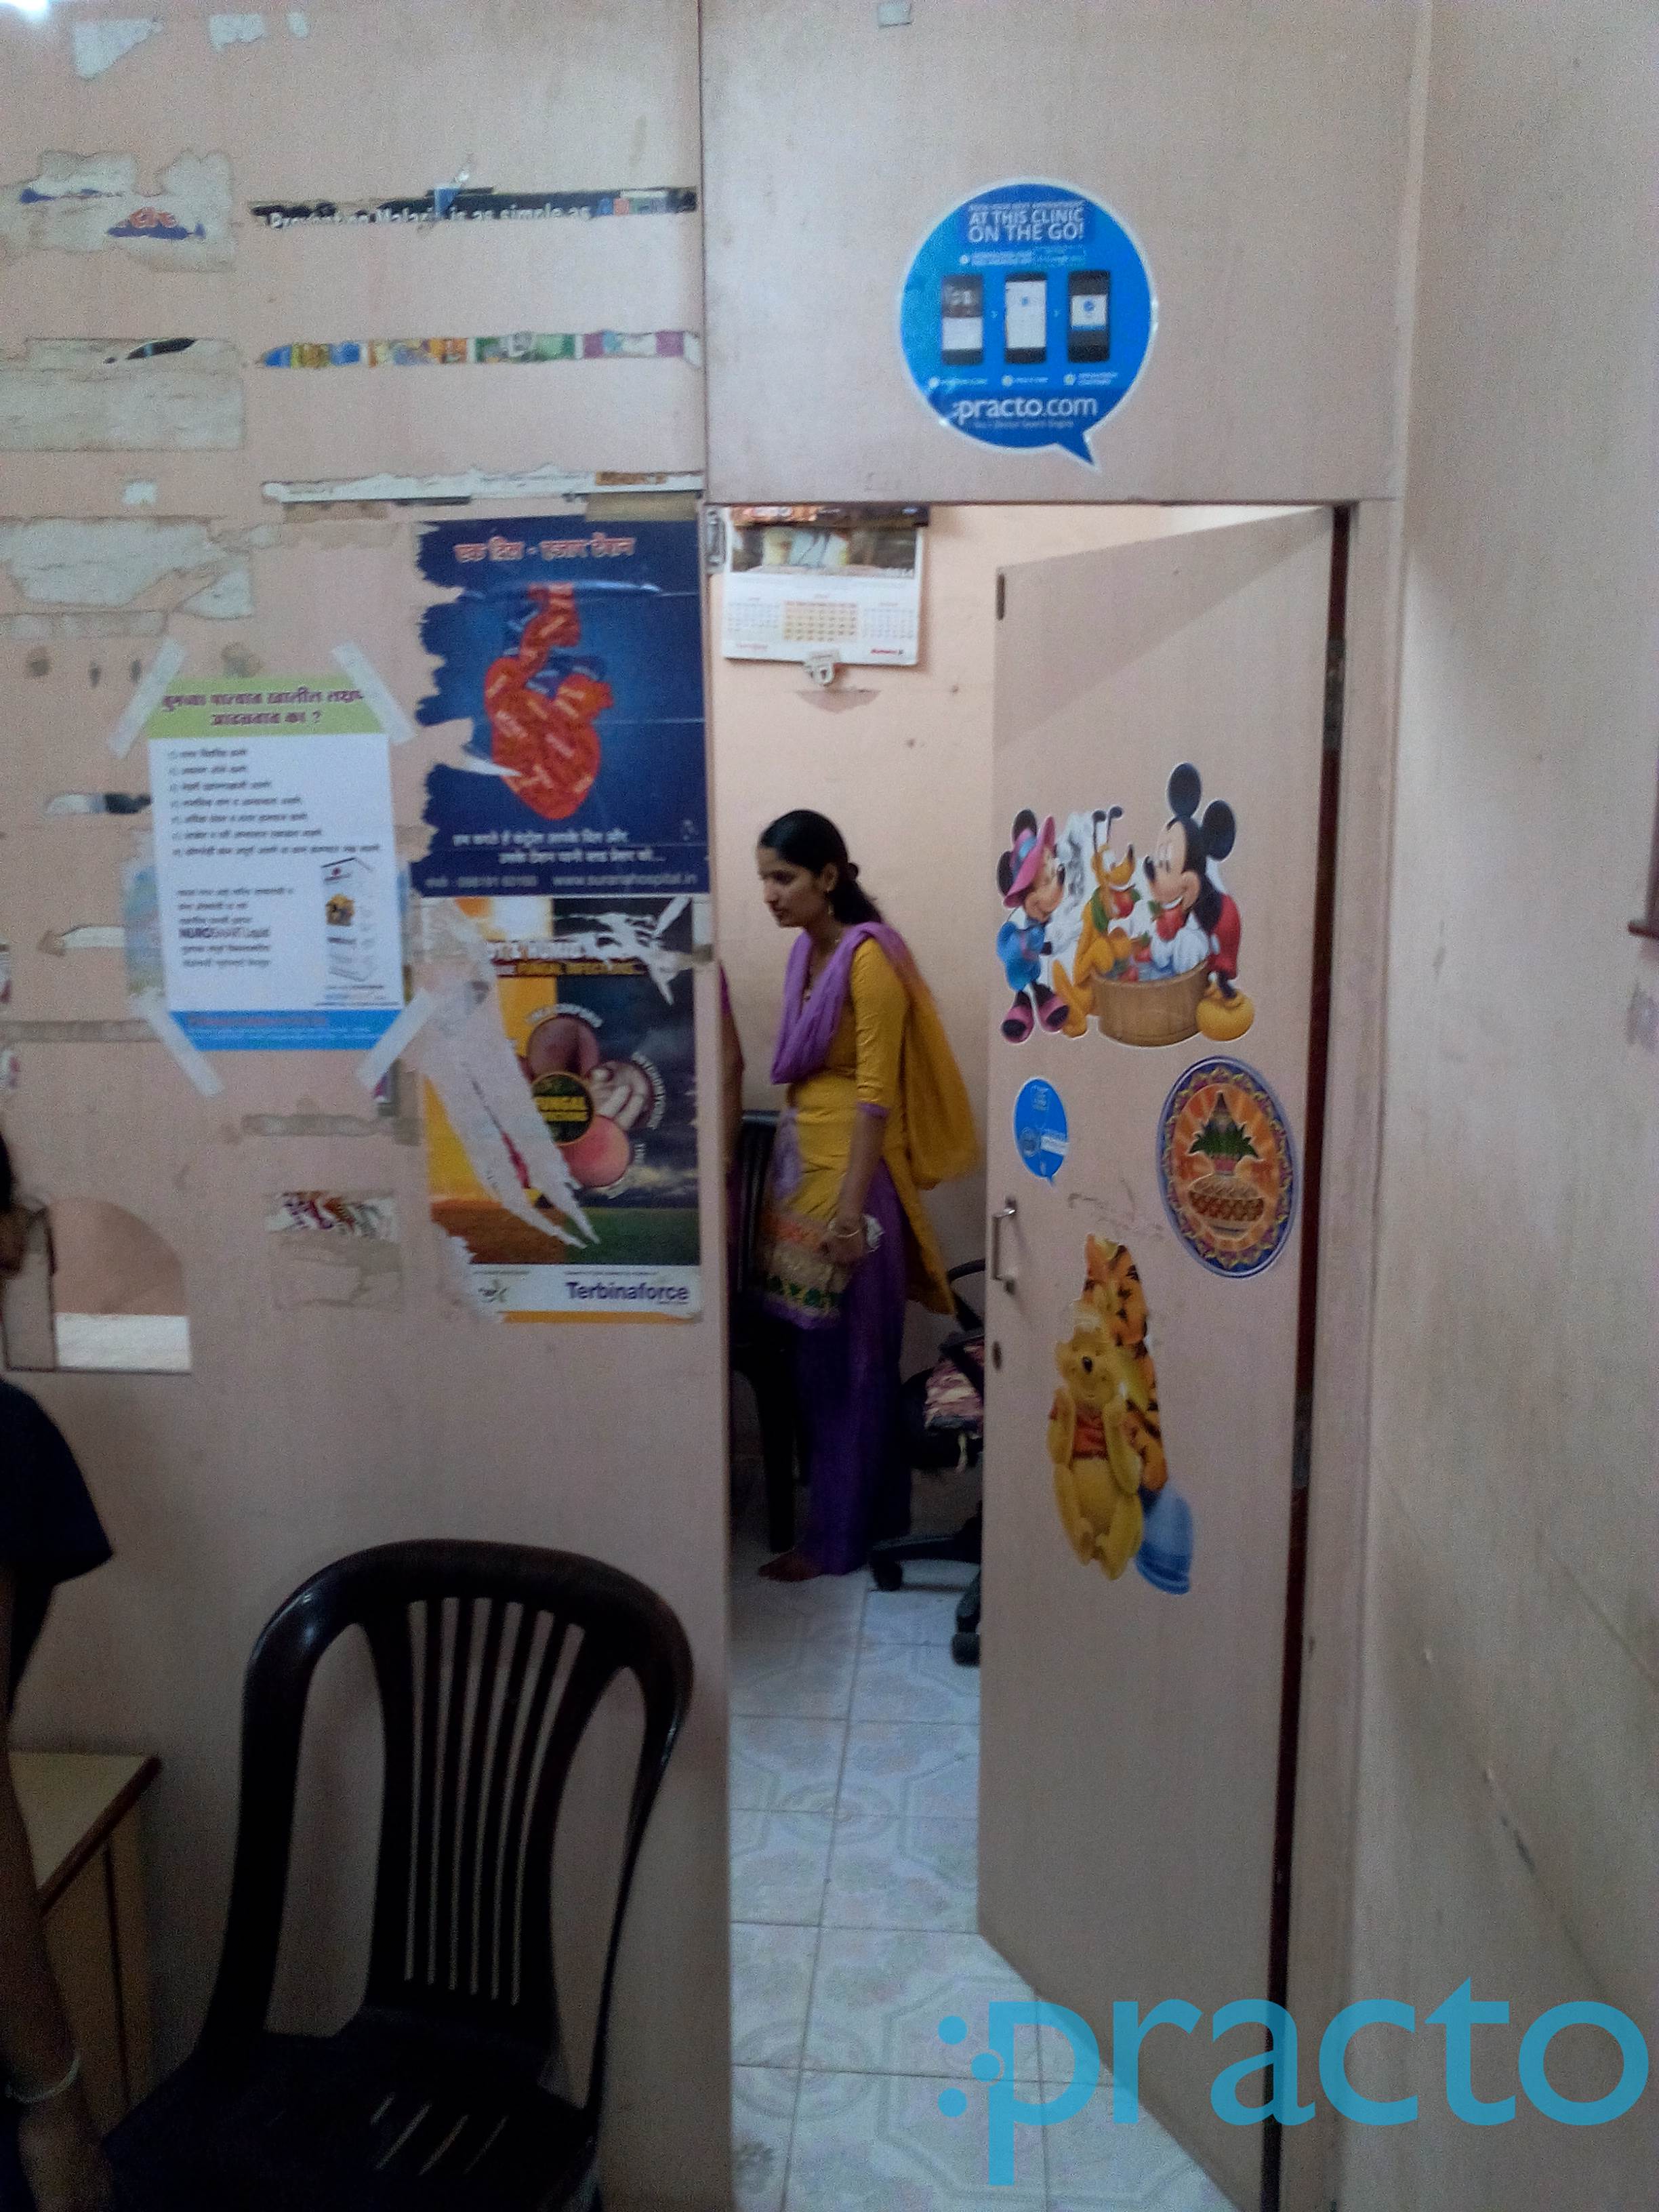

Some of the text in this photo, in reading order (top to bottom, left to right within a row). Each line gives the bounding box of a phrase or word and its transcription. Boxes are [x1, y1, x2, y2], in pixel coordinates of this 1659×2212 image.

[375, 206, 447, 224] Malari
[969, 222, 1084, 243] ON THE GO!
[565, 1282, 690, 1300] Terbinaforce
